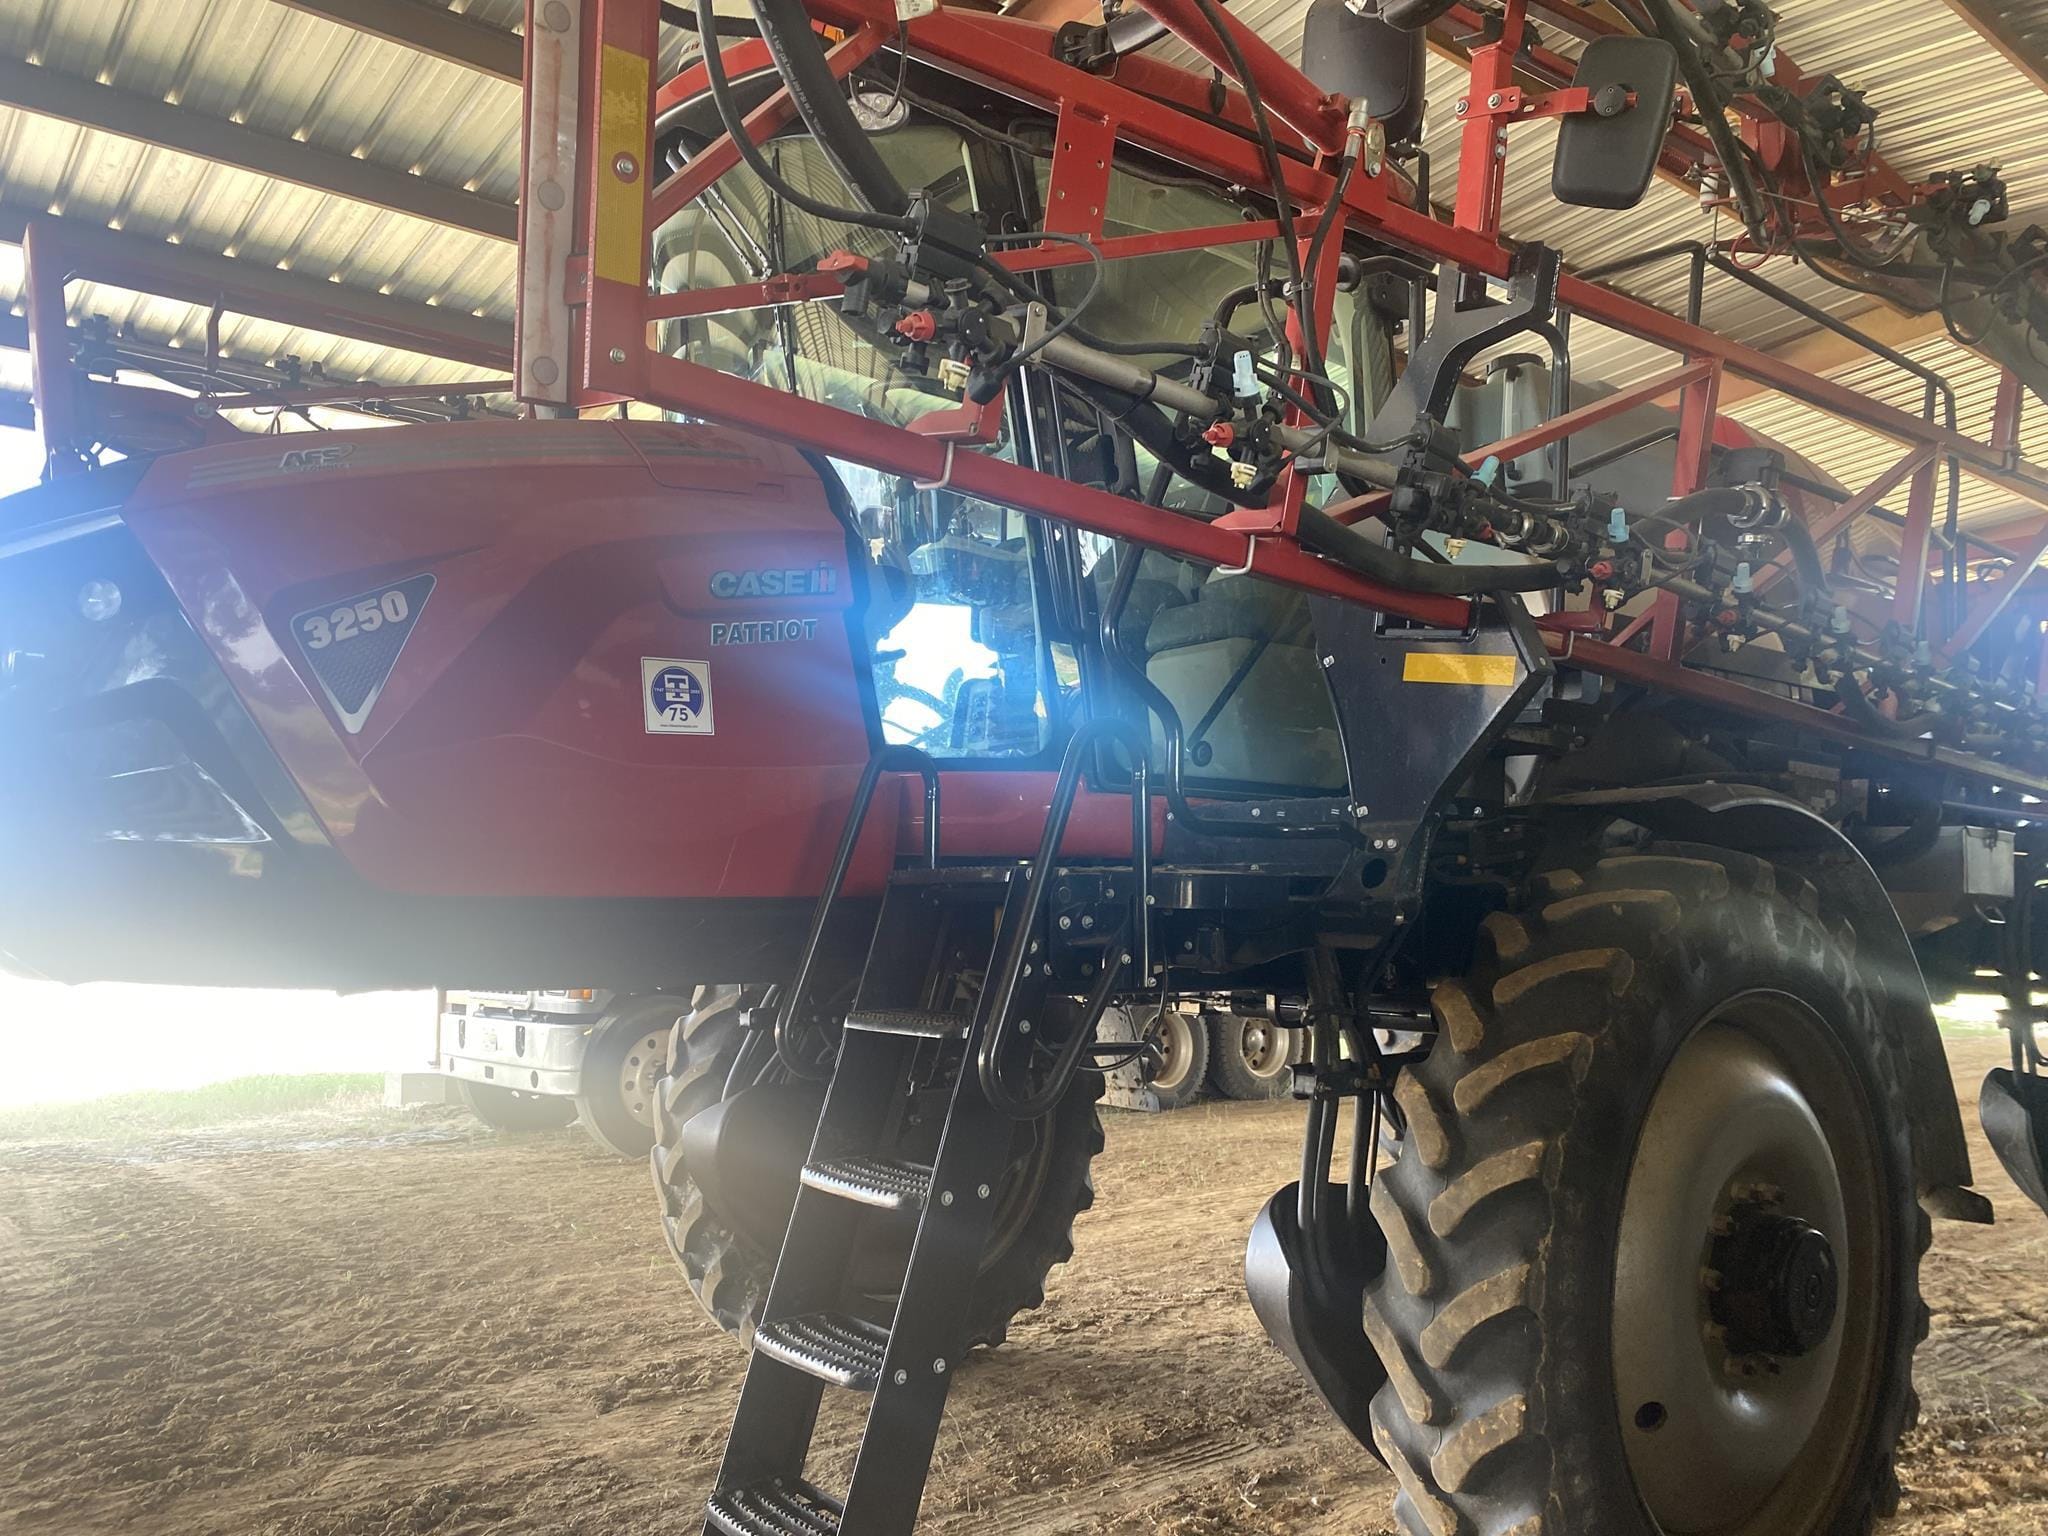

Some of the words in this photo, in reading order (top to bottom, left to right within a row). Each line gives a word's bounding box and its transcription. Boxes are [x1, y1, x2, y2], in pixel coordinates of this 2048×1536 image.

[279, 446, 343, 468] AFS
[710, 569, 806, 597] CASE
[303, 590, 409, 649] 3250
[710, 618, 818, 646] PATRIOT
[669, 707, 688, 721] 75
